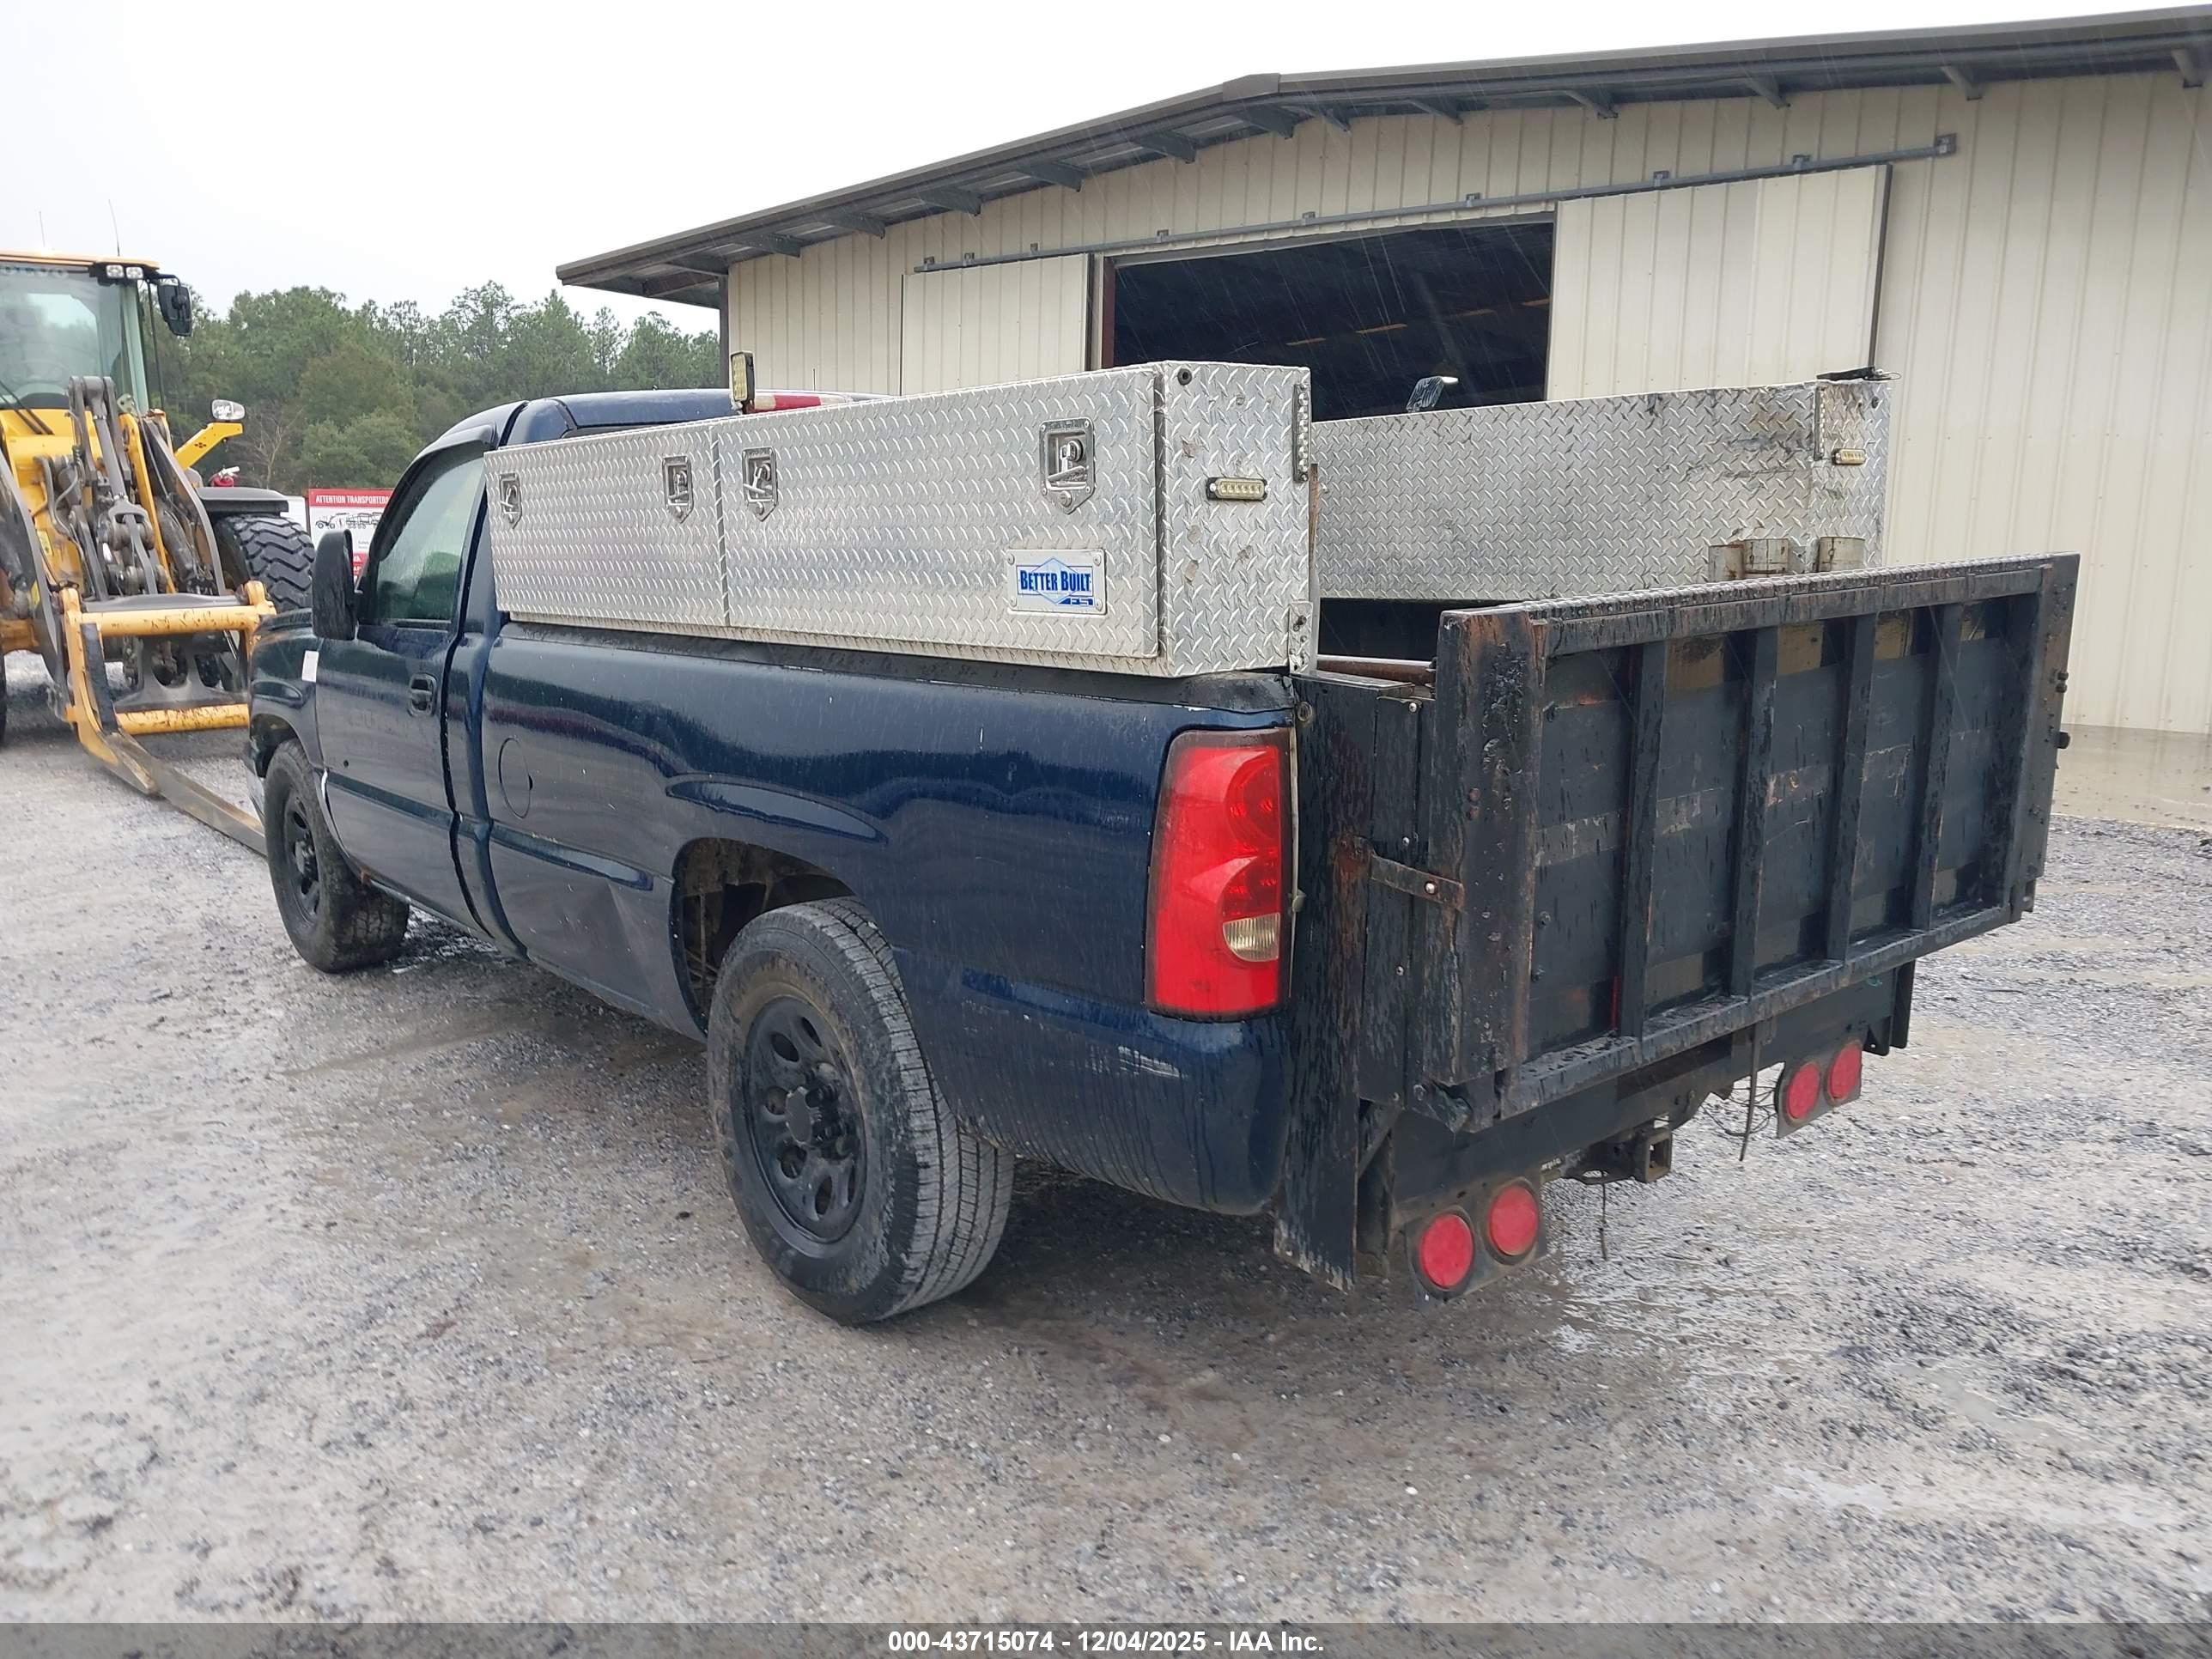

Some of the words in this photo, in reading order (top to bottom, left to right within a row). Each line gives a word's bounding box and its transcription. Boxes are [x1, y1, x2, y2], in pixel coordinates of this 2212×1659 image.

[315, 495, 346, 504] ATTENTION
[1020, 570, 1058, 591] BETTER
[1060, 571, 1091, 592] BUILT
